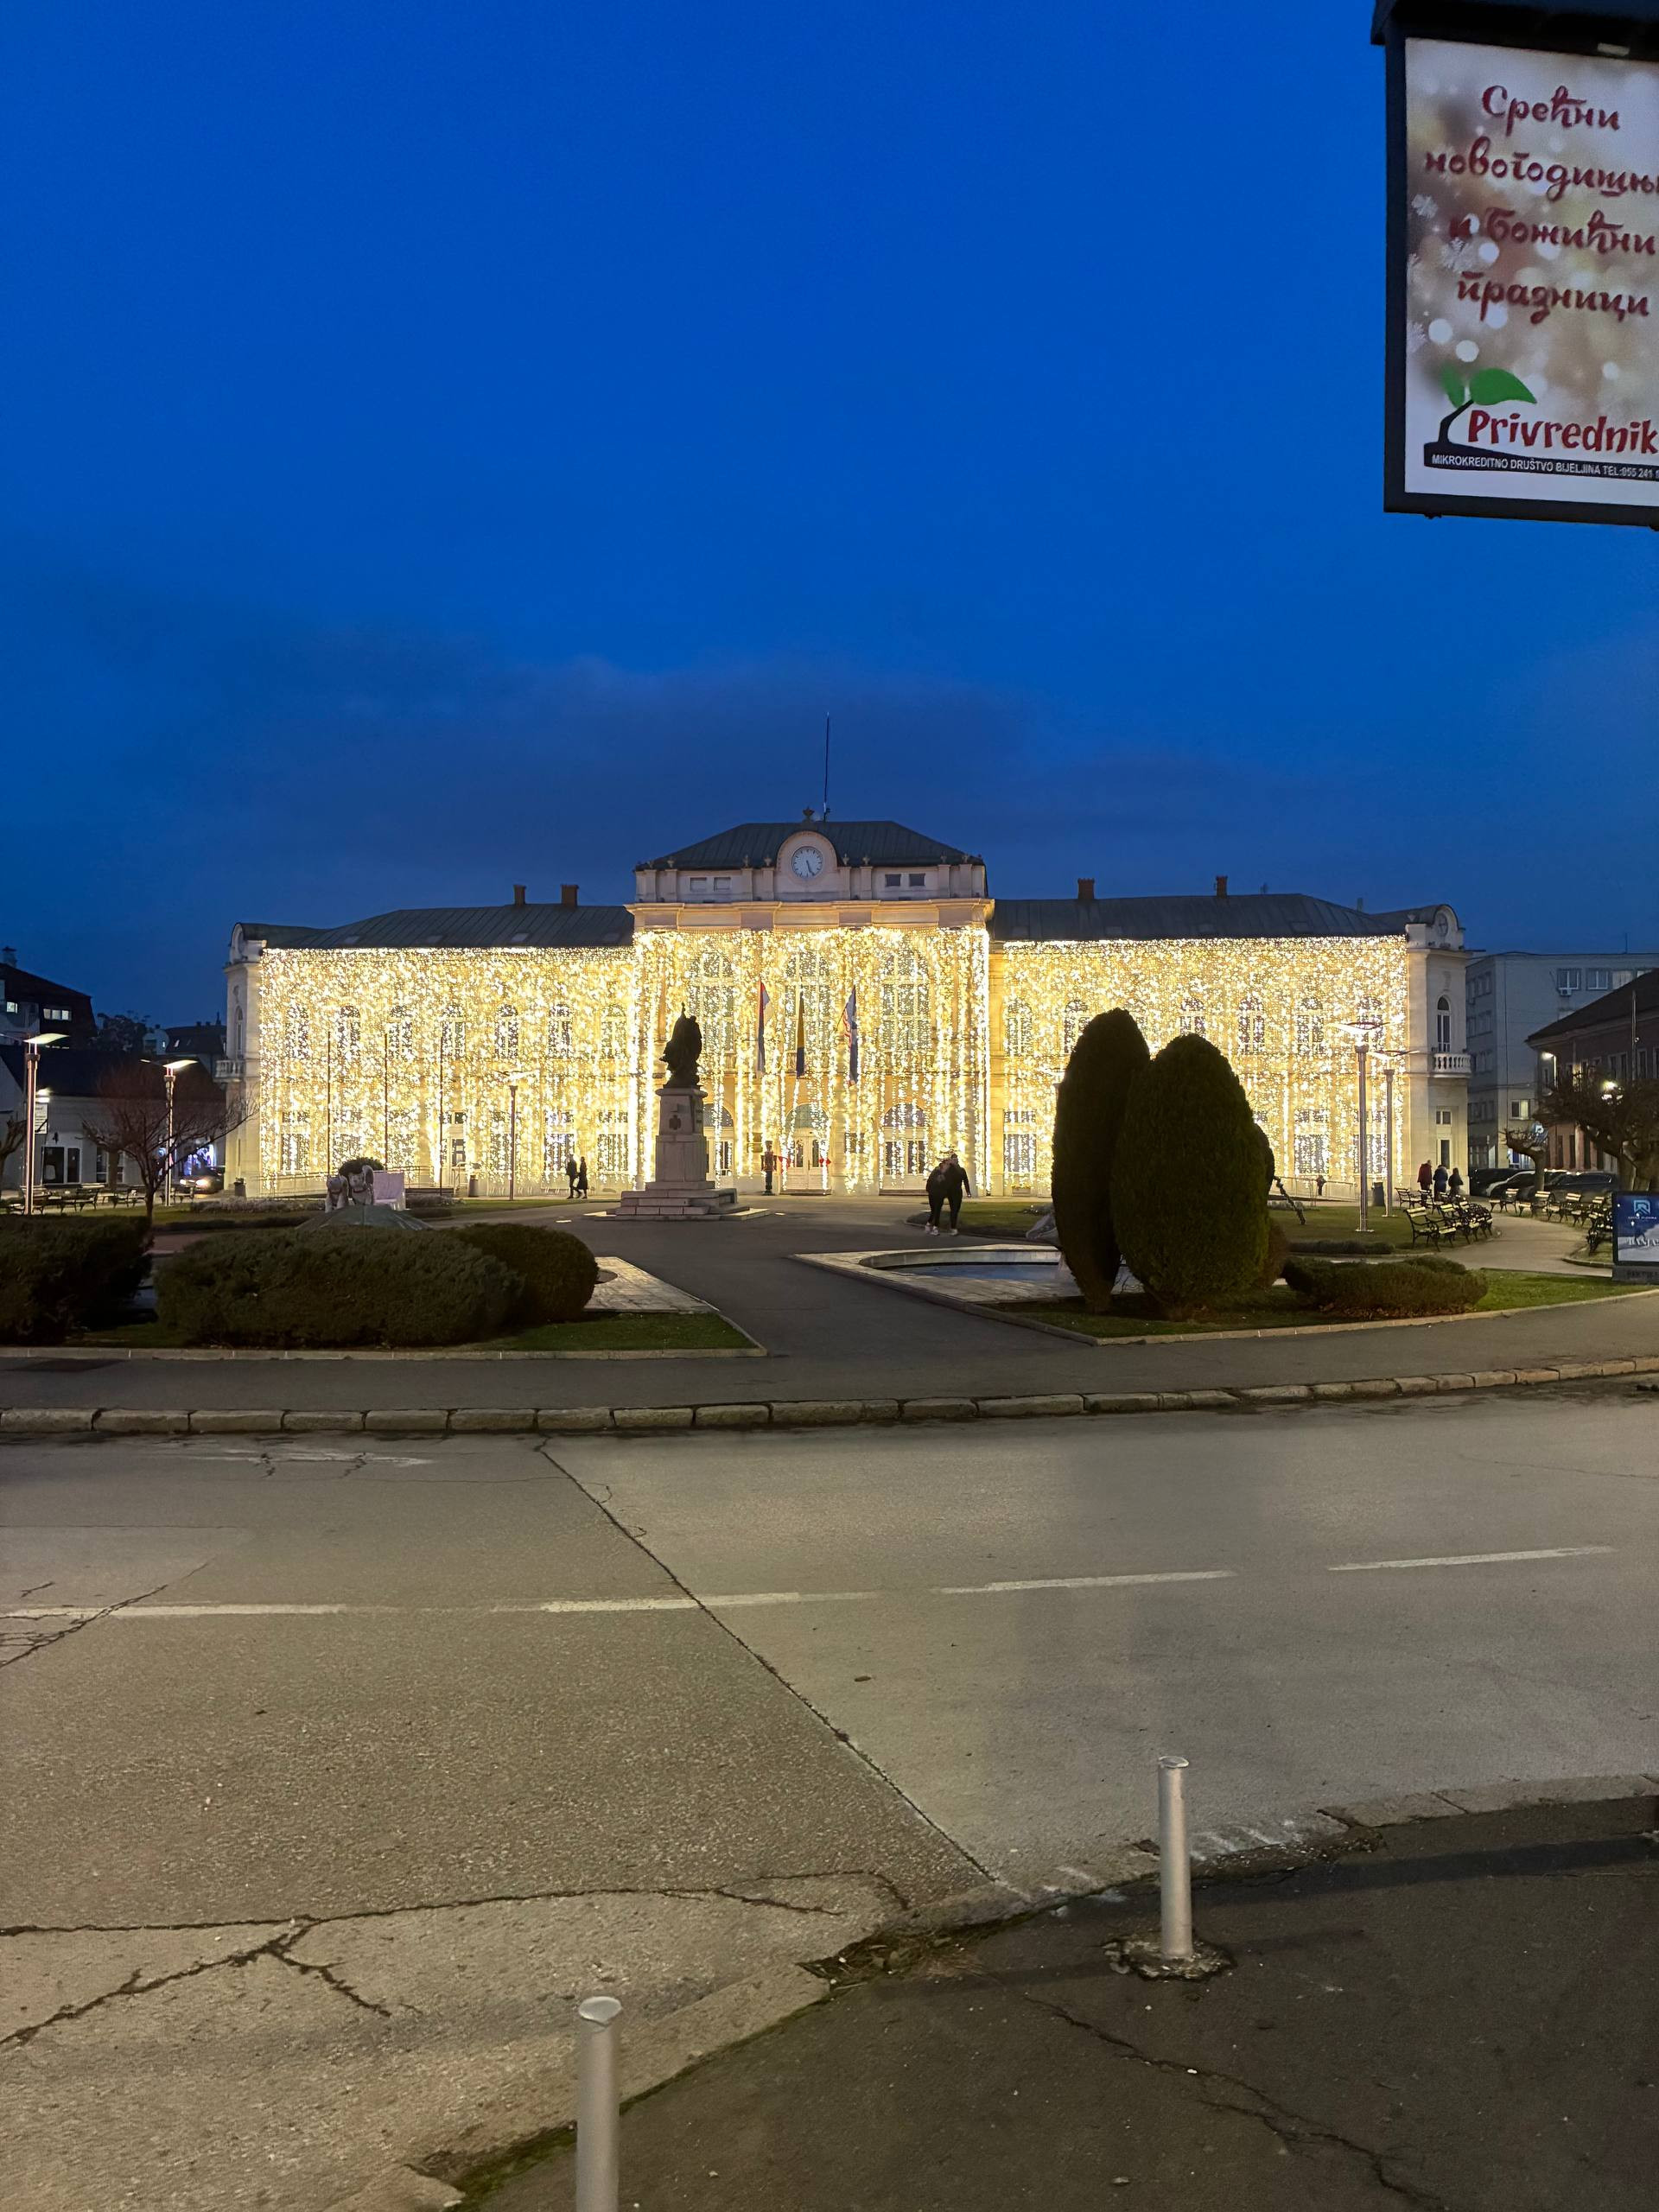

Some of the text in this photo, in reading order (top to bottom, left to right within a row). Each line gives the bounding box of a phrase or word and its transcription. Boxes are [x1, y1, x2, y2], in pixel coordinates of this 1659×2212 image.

[1482, 85, 1621, 137] Срећни
[1426, 136, 1659, 202] новогодишњ
[1449, 216, 1472, 239] и
[1458, 270, 1649, 325] празници
[1468, 410, 1658, 454] Privrednik
[1432, 454, 1509, 468] MIKROKREDITNO
[1510, 458, 1554, 472] DRUŠTVO
